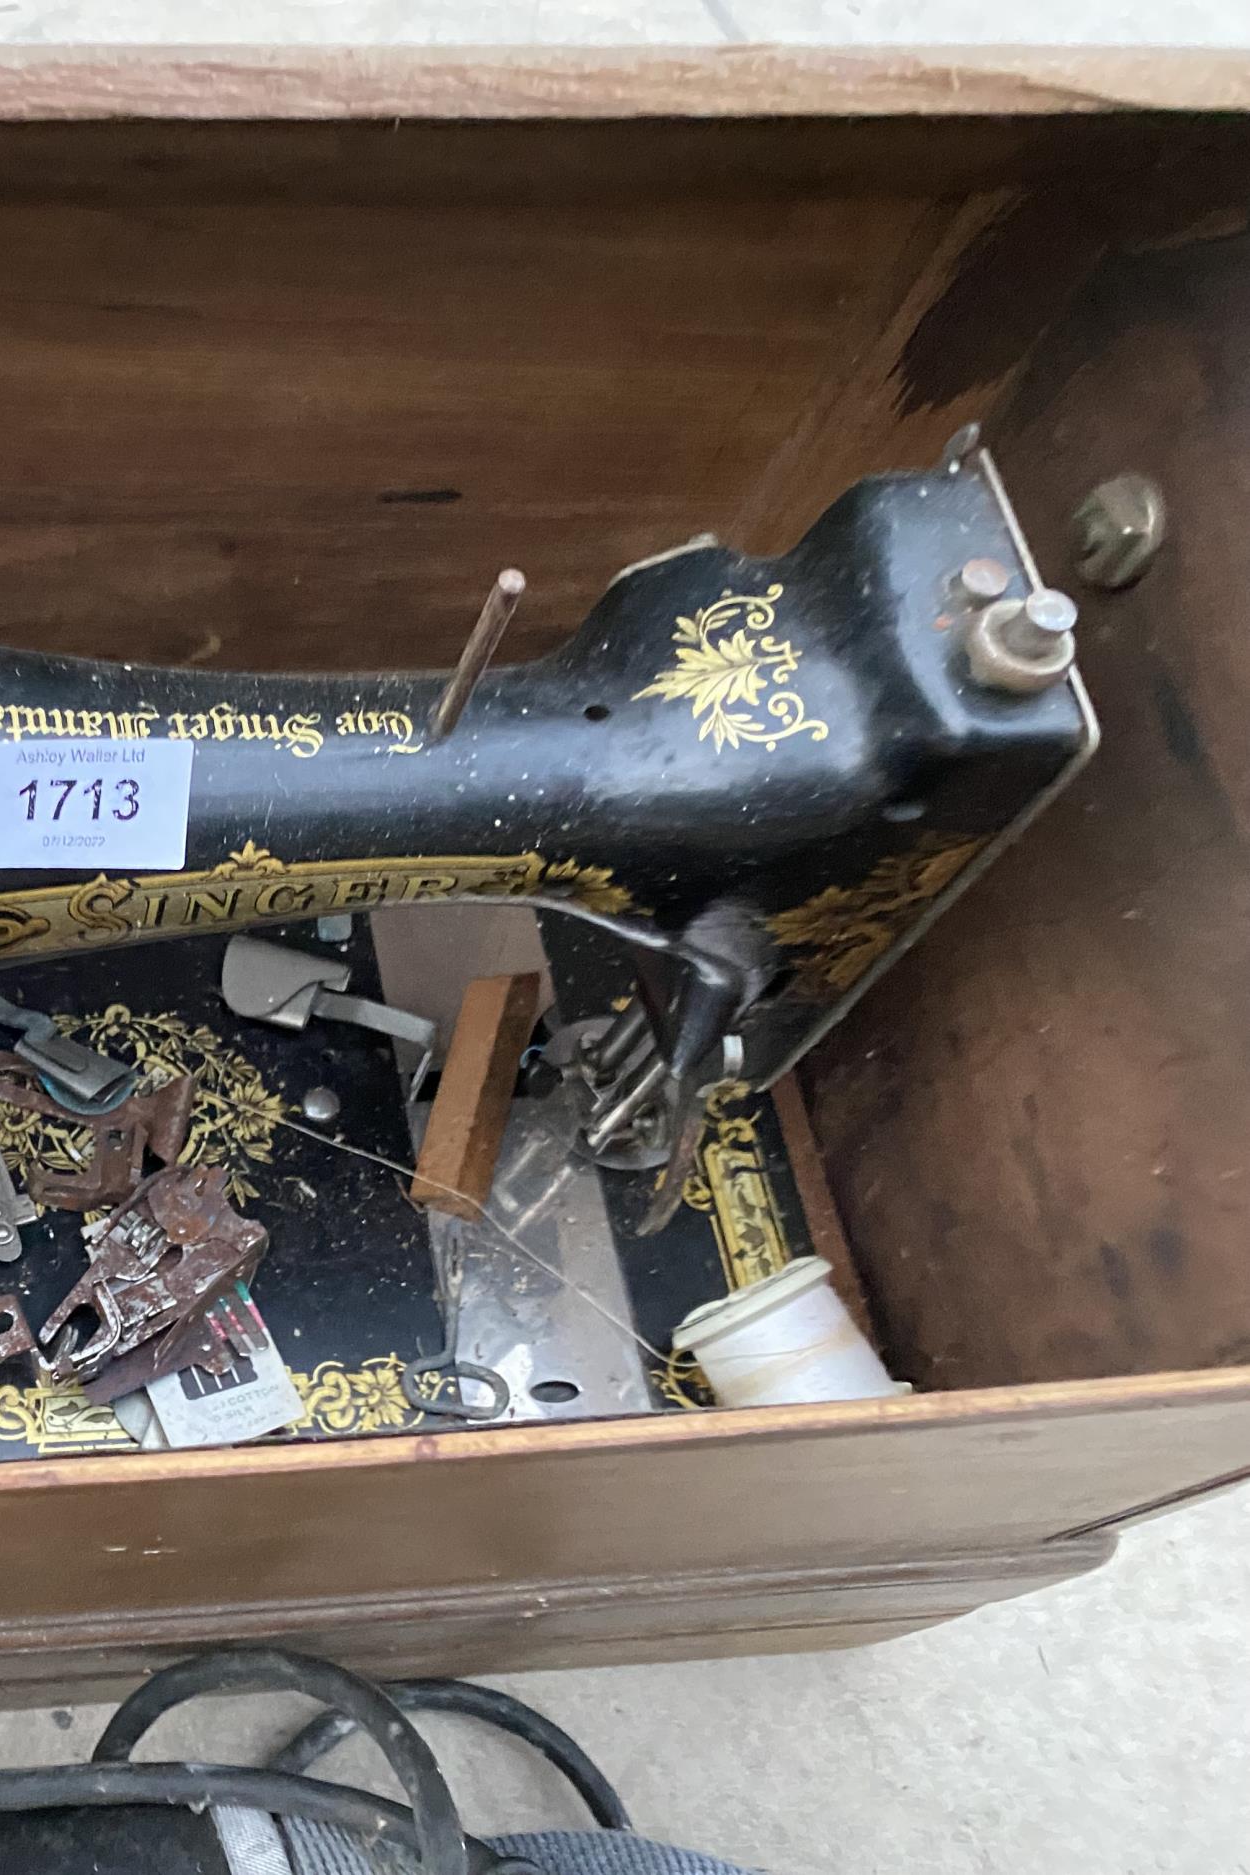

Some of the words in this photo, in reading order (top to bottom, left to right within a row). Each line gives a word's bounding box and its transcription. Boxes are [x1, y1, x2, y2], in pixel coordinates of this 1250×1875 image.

[168, 702, 324, 758] Singer
[17, 749, 66, 766] Ashby
[71, 748, 118, 764] Waller
[122, 748, 145, 763] Ltd
[19, 778, 140, 821] 1713
[42, 835, 106, 848] 07/12/2022
[67, 874, 459, 944] SINGER
